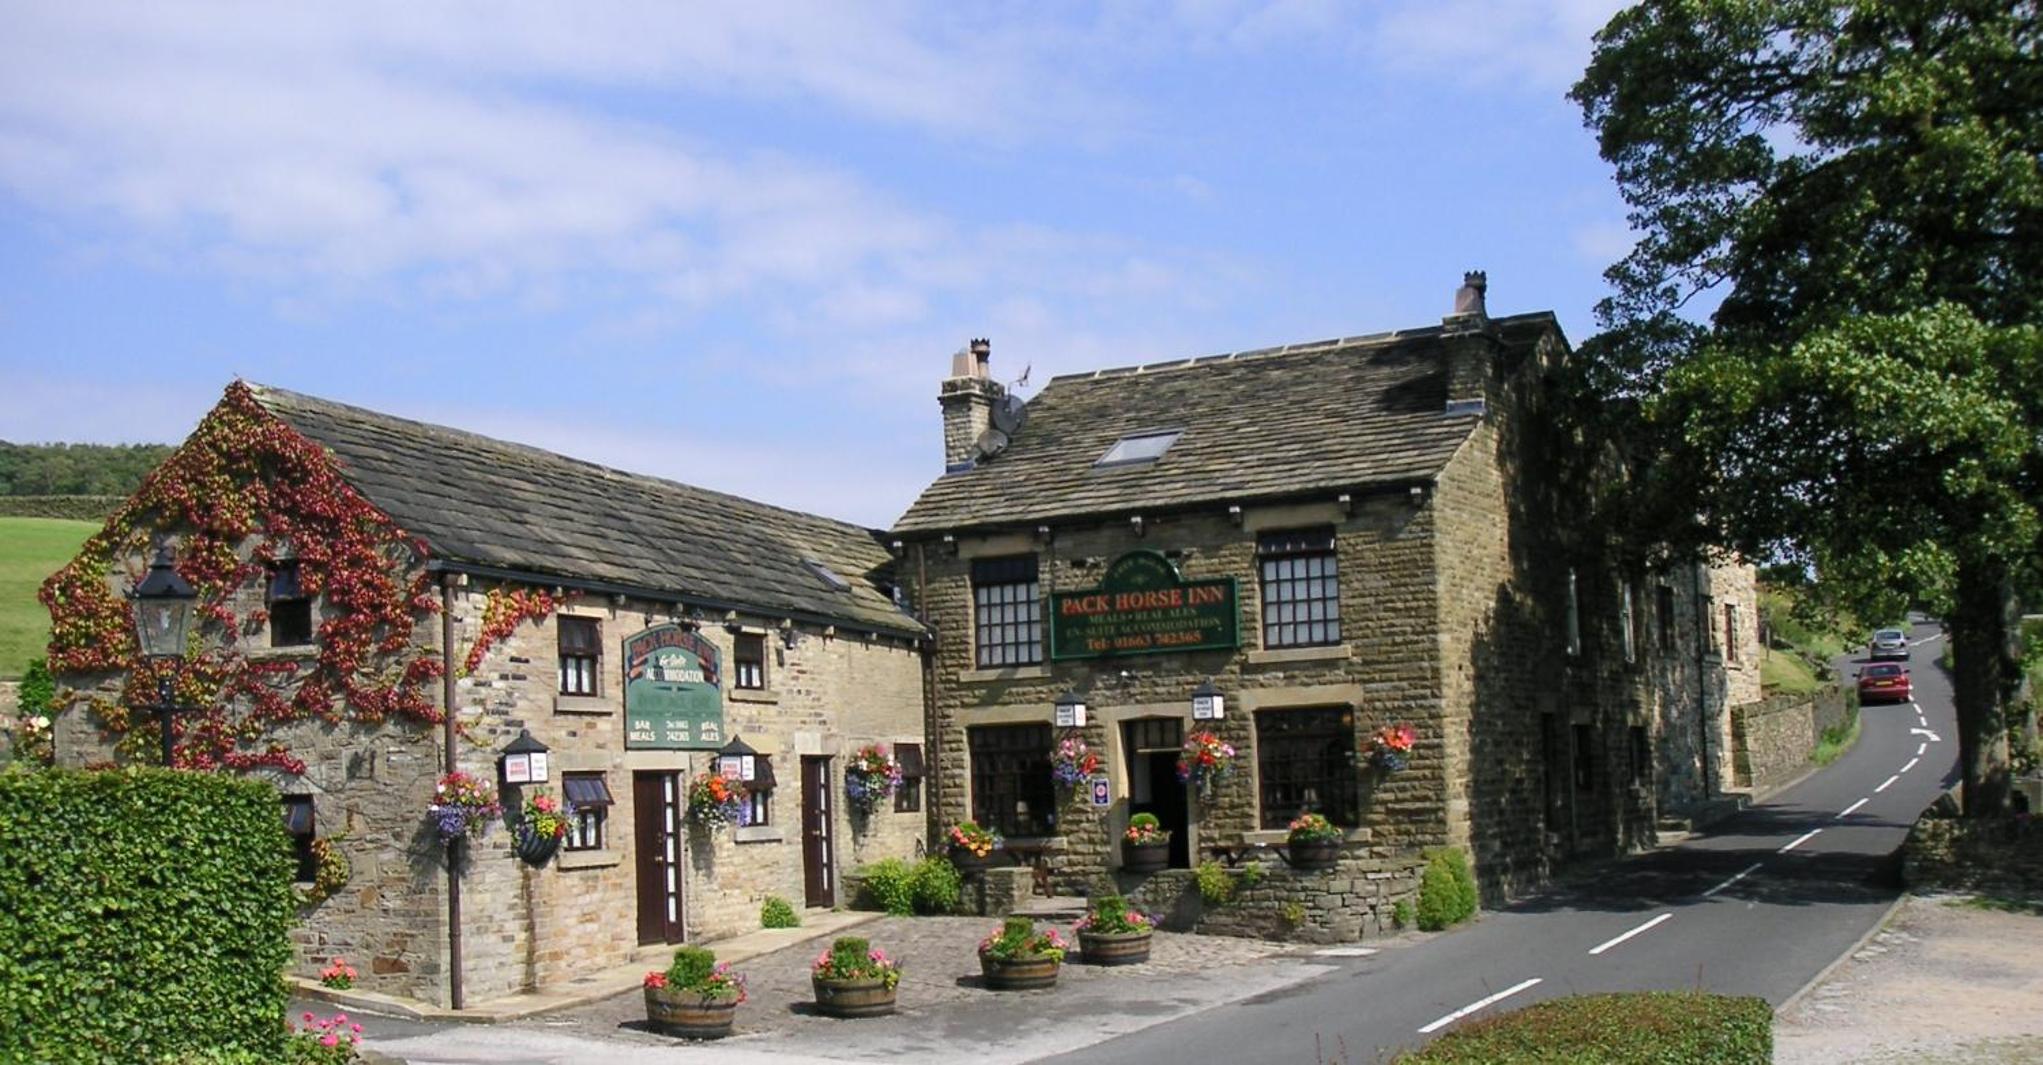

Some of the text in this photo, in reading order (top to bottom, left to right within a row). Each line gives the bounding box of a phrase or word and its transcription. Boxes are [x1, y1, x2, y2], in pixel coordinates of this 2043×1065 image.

[1061, 586, 1224, 615] PACK HORSE INN
[1169, 607, 1198, 619] ALES
[660, 631, 695, 650] HORSE
[1087, 637, 1111, 650] Tel:
[635, 720, 650, 730] BAR
[701, 721, 719, 731] REAL
[630, 731, 656, 742] MEALS
[700, 731, 720, 742] ALES
